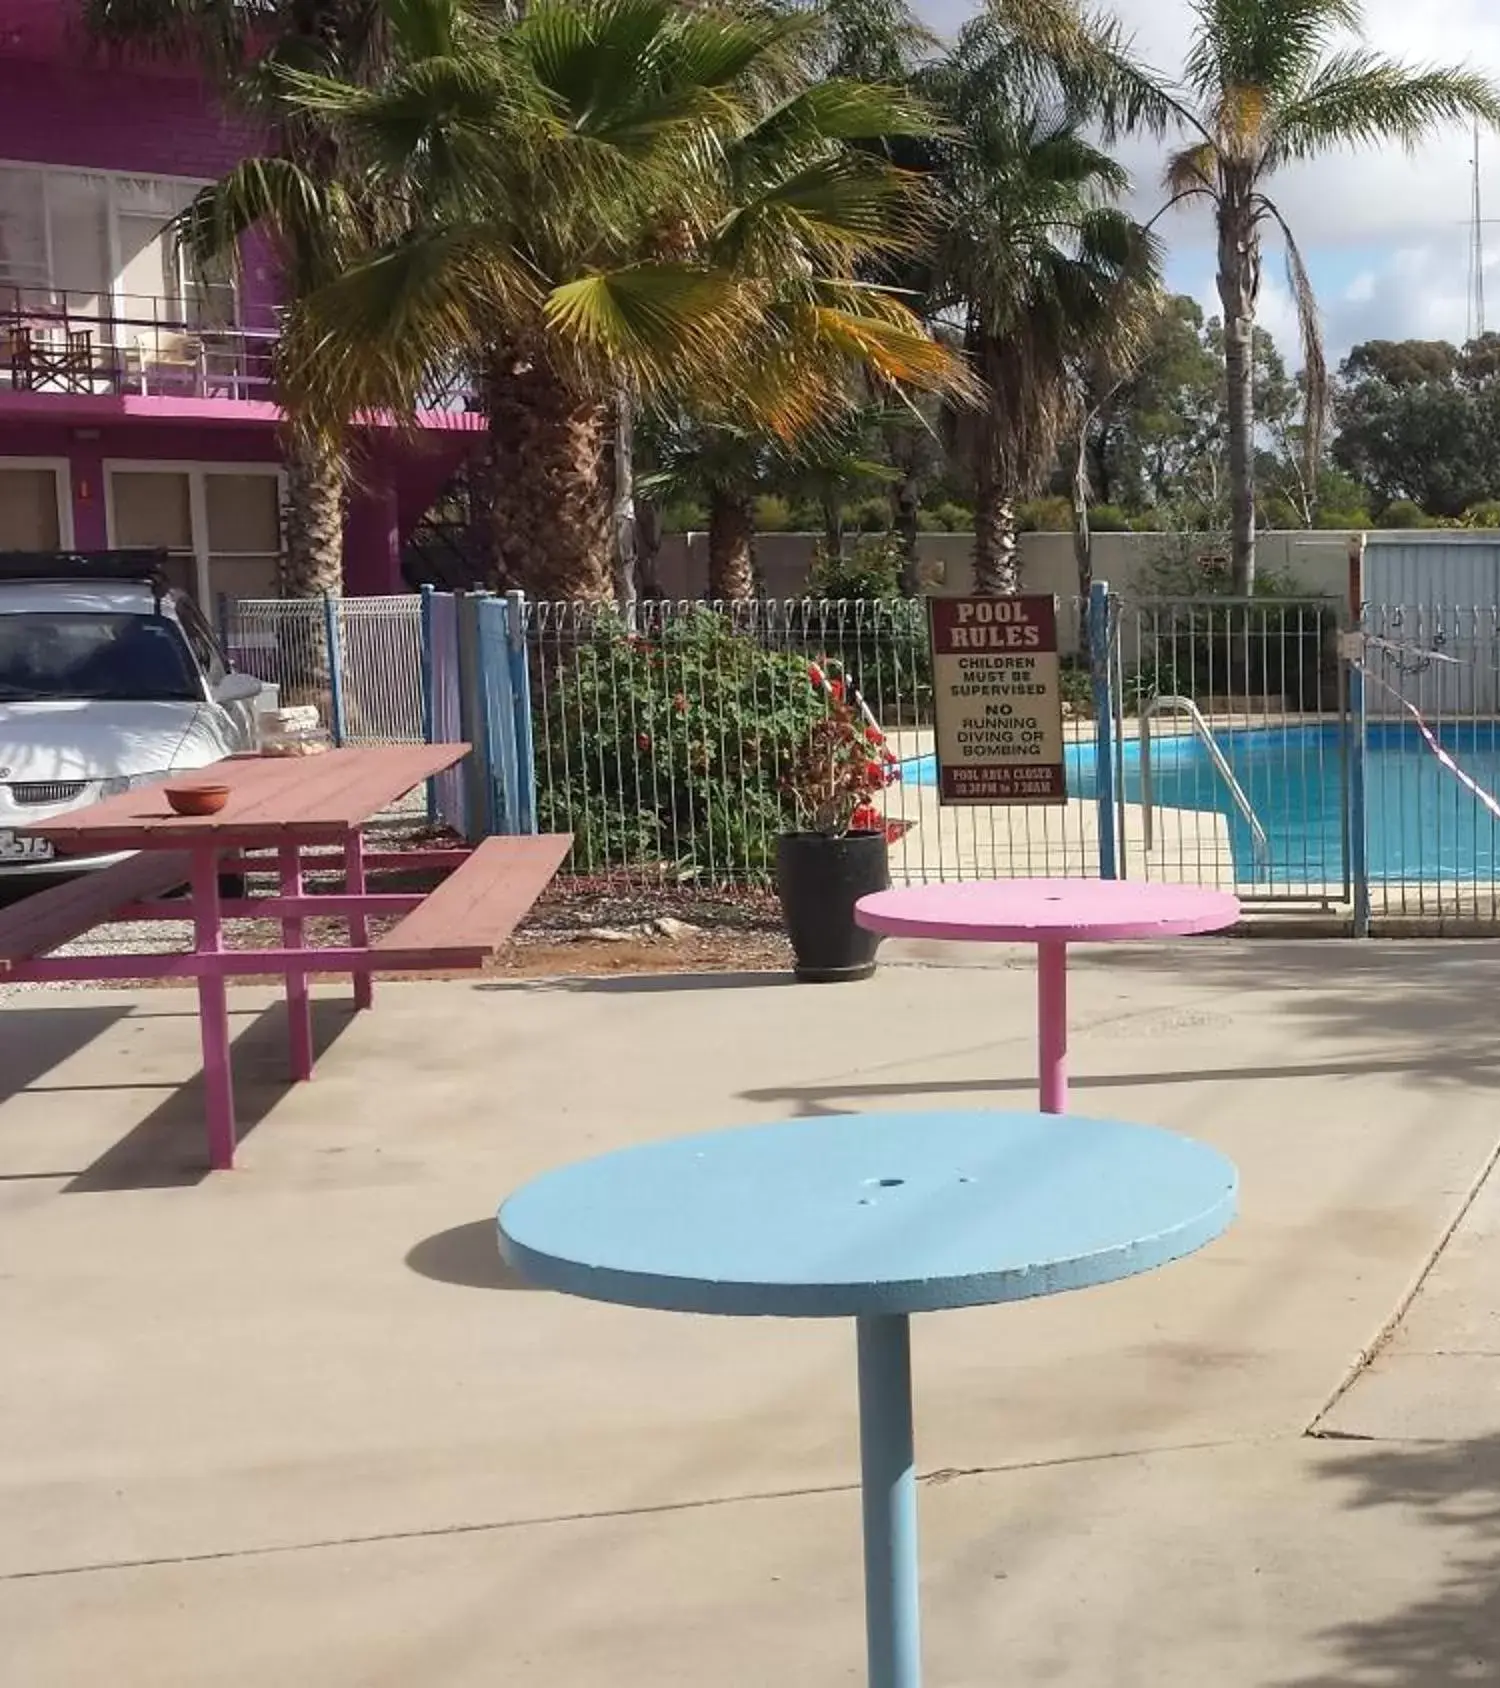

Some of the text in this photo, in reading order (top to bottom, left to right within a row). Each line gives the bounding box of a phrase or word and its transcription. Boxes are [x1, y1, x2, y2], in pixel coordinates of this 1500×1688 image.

[957, 602, 1029, 623] POOL
[950, 625, 1040, 647] RULES
[959, 657, 1035, 669] CHILDREN
[963, 671, 1031, 682] MUST BE
[951, 684, 1046, 696] SUPERVISED
[985, 704, 1012, 715] NO
[963, 718, 1037, 730] RUNNING
[958, 731, 1044, 743] DIVING OR
[963, 744, 1040, 757] BOMBING
